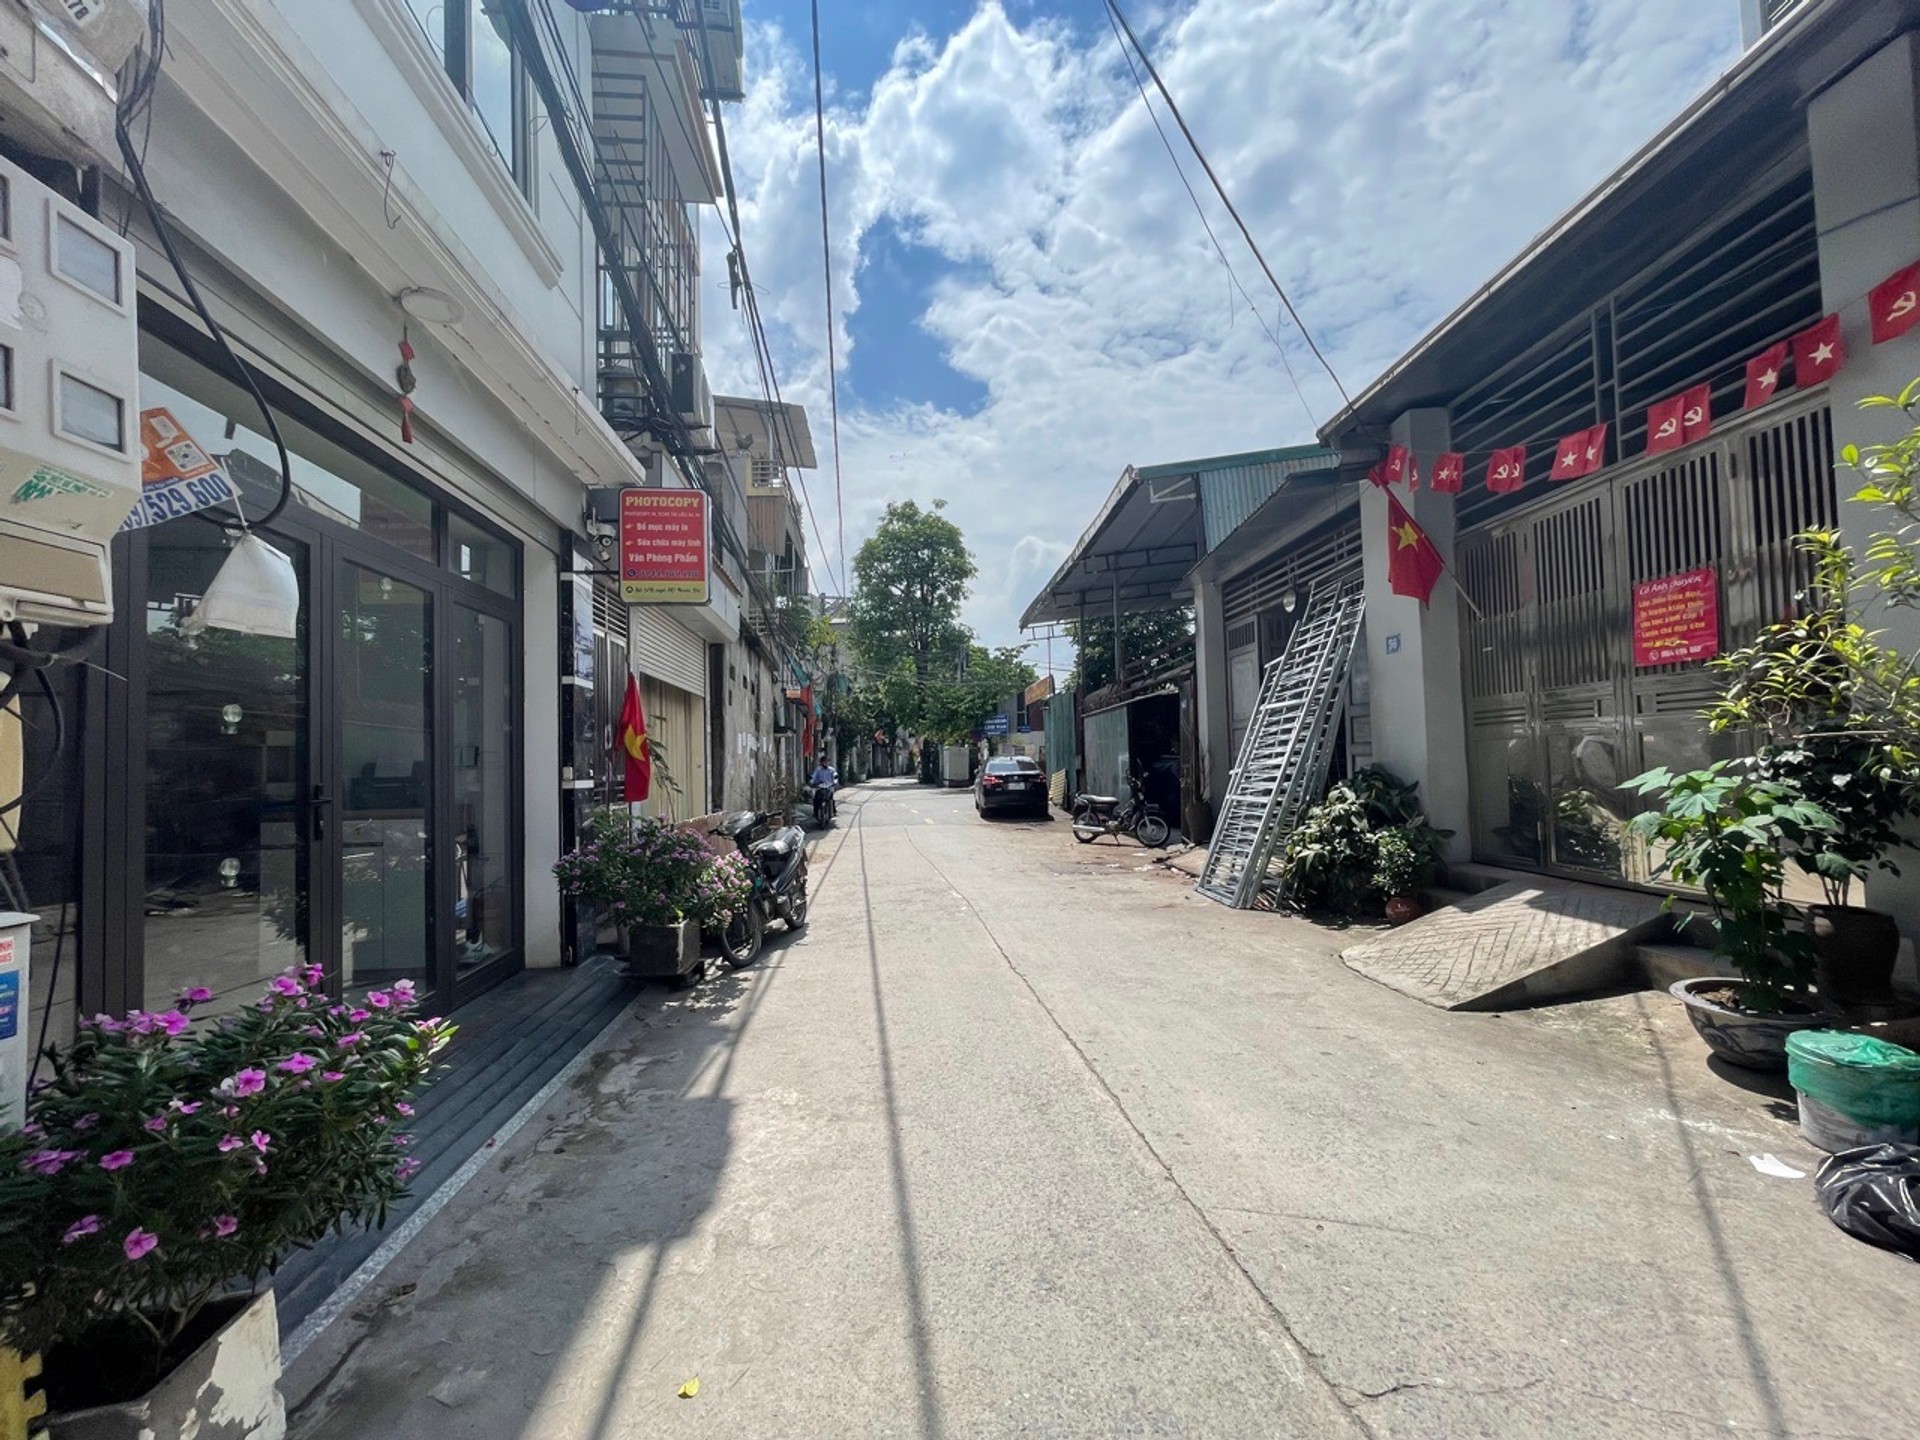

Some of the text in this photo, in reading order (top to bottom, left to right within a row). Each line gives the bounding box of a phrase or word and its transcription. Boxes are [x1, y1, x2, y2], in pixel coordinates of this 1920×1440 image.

[625, 496, 700, 508] PHOTOCOPY
[664, 523, 680, 532] máy
[681, 523, 688, 531] in
[628, 552, 699, 564] Văn Phòng Phẩm
